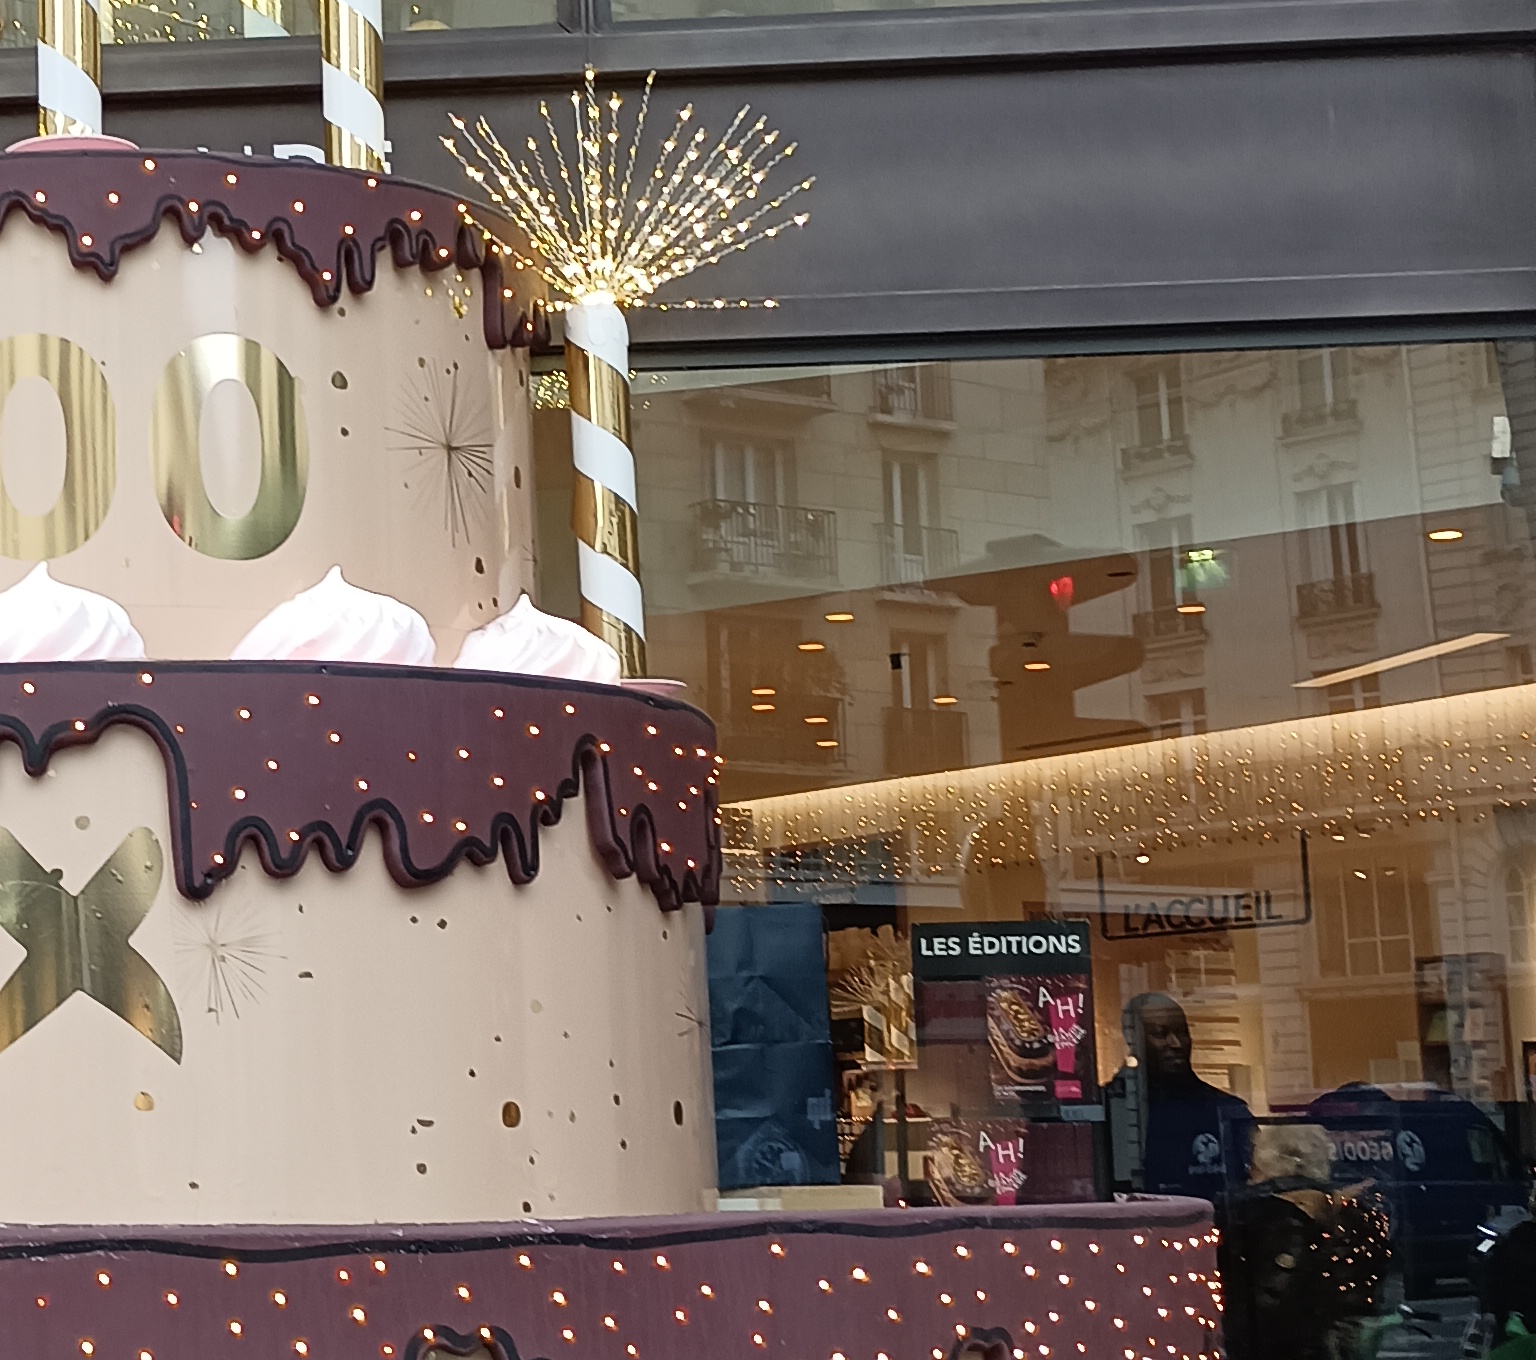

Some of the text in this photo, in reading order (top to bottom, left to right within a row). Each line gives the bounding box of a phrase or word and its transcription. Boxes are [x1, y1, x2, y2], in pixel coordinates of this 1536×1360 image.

[920, 932, 1082, 956] LES ÉDITIONS
[1038, 986, 1084, 1019] AH!
[979, 1130, 1024, 1164] AH!
